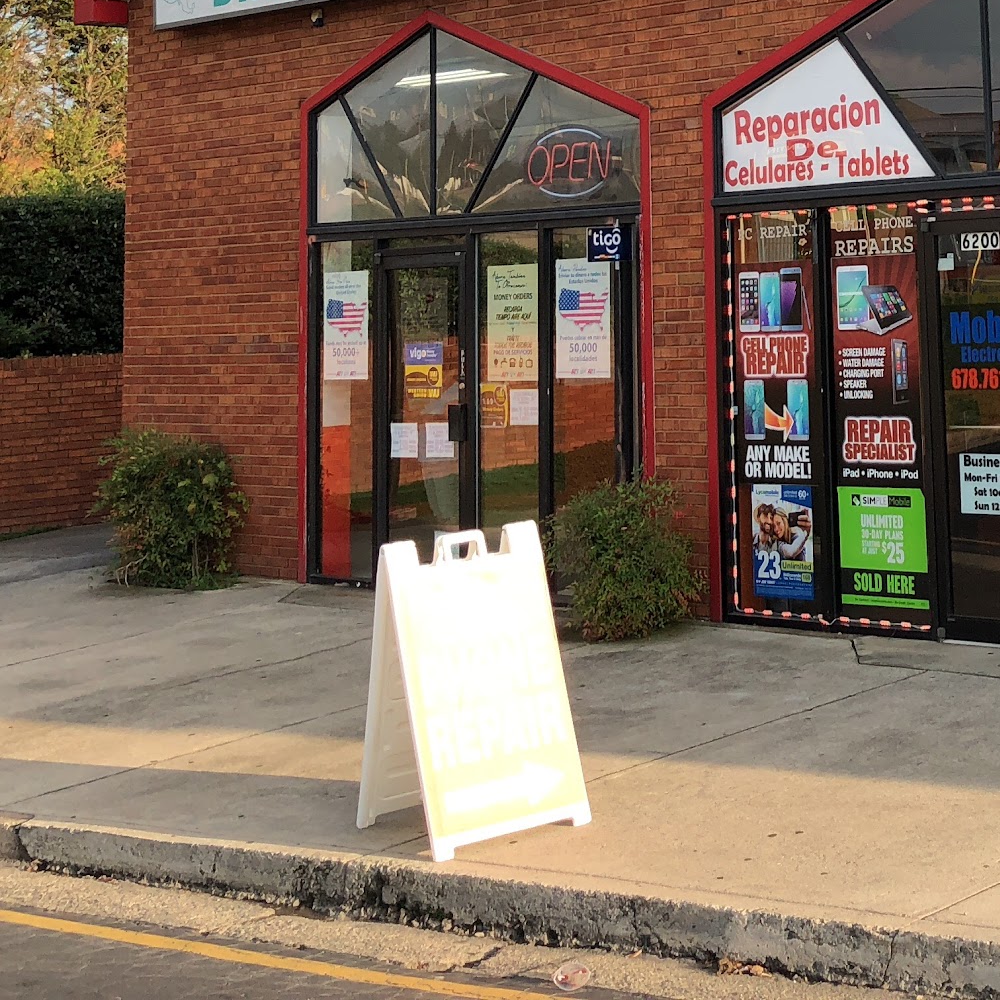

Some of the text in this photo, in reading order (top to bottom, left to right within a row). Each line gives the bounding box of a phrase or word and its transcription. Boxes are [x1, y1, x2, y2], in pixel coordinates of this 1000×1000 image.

[734, 93, 881, 147] Reparacion
[786, 138, 839, 163] De
[527, 140, 612, 187] OPEN
[725, 156, 814, 187] Celulares
[835, 146, 910, 178] Tablets
[760, 224, 807, 239] REPAIR
[835, 216, 914, 233] CELL PHONE
[835, 236, 914, 257] REPAIRS
[963, 232, 999, 249] 6200
[569, 342, 598, 354] 50,000
[743, 336, 807, 352] CELL PHONE
[842, 347, 886, 357] SCREEN DAMAGE
[745, 350, 805, 375] REPAIR
[843, 358, 885, 367] WATER DAMAGE
[843, 368, 884, 378] CHARGING PORT
[843, 379, 867, 389] SPEAKER
[844, 390, 873, 400] UNLOCKING
[847, 419, 911, 443] REPAIR
[746, 446, 810, 463] ANY MAKE
[844, 443, 915, 461] SPECIALIST
[745, 462, 812, 479] OR MODEL!
[843, 468, 918, 480] iPad iPhone iPod
[964, 472, 998, 483] Mon-Fri
[974, 487, 987, 497] Sat
[889, 497, 910, 506] Mobile
[974, 501, 990, 511] Sun
[861, 514, 903, 529] UNLIMITED
[885, 530, 903, 540] PLANS
[882, 541, 904, 564] $25
[755, 549, 781, 579] $23
[782, 561, 812, 571] Unlimited
[854, 572, 915, 595] SOLD HERE
